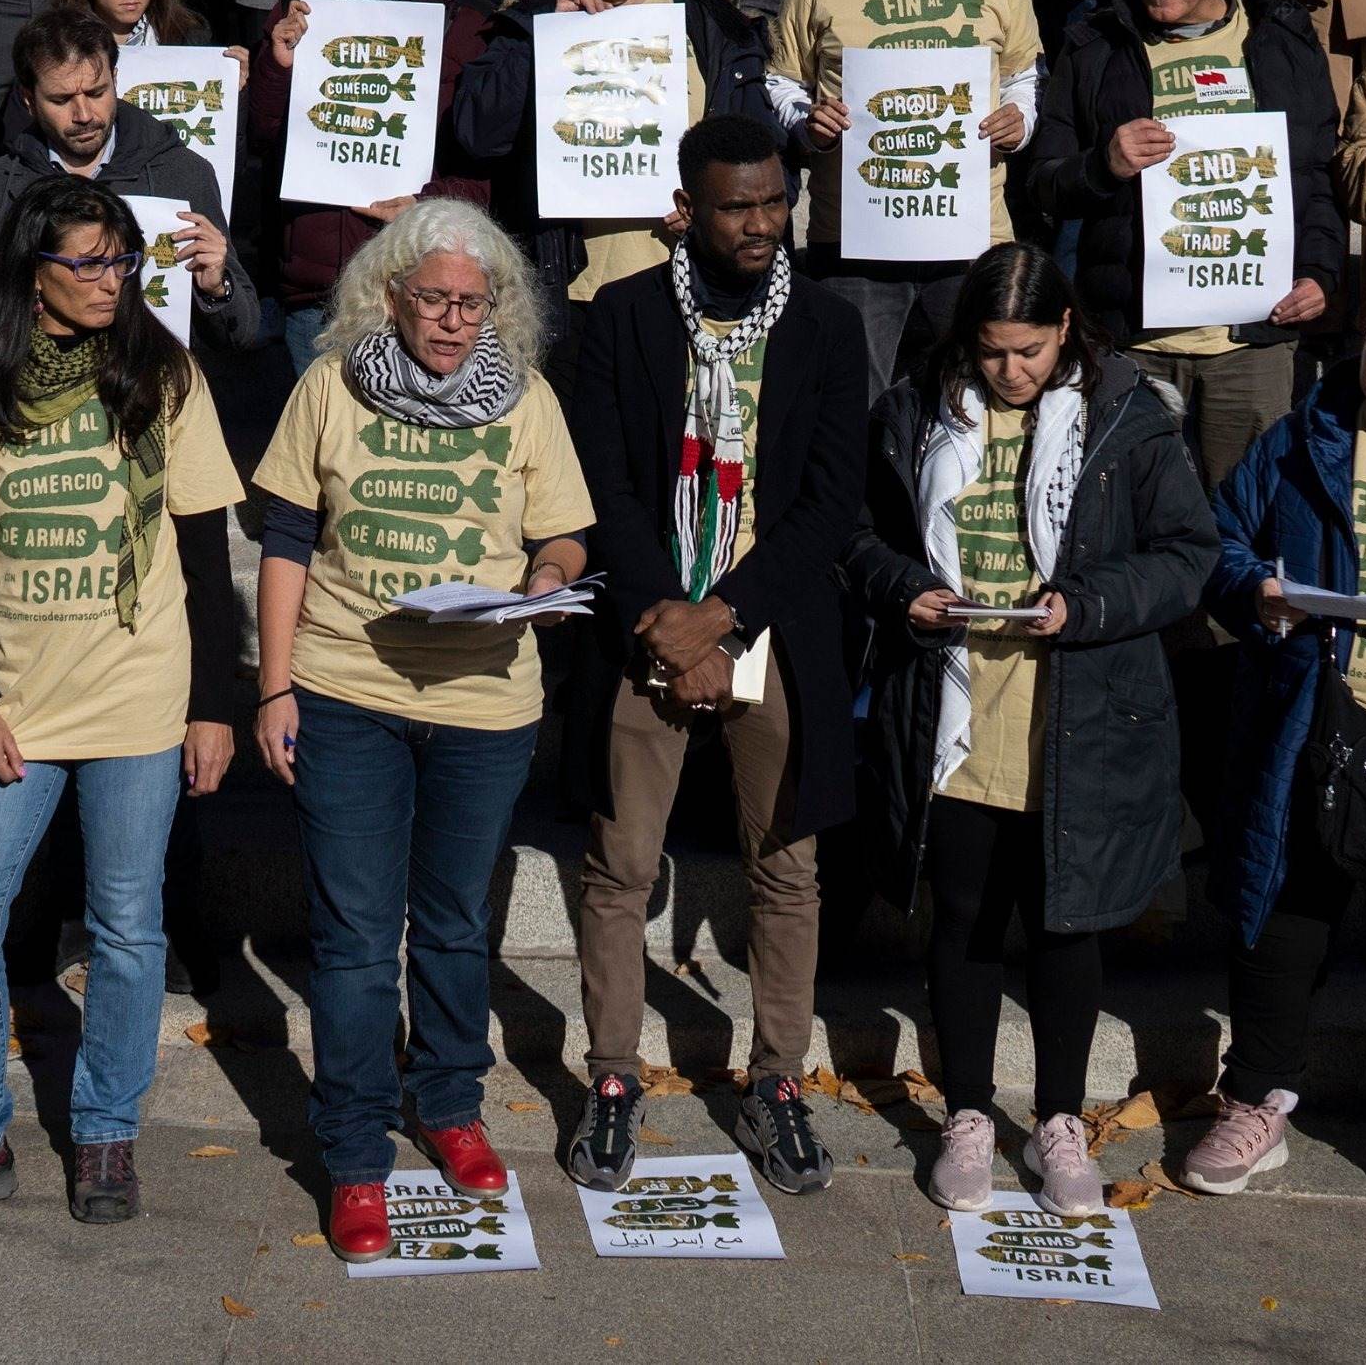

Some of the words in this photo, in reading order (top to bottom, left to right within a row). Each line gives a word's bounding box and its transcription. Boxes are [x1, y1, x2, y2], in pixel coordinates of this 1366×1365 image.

[340, 43, 370, 63] FIN
[1159, 65, 1196, 91] FIN
[327, 83, 387, 96] COMERCIO
[1200, 89, 1247, 97] INTERSINDICAL
[138, 91, 169, 110] FIN
[319, 111, 331, 124] DE
[335, 114, 374, 130] ARMAS
[575, 122, 625, 141] TRADE
[876, 132, 934, 151] COMERÇ
[330, 140, 401, 167] ISRAEL
[582, 153, 659, 178] ISRAEL
[1189, 154, 1236, 182] END
[869, 166, 930, 185] D'ARMES
[884, 195, 958, 219] ISRAEL
[1181, 202, 1196, 212] THE
[1200, 198, 1243, 216] ARMS
[1182, 233, 1231, 250] TRADE
[1188, 263, 1264, 287] ISRAEL
[79, 413, 99, 431] AL
[384, 421, 429, 454] FIN
[440, 433, 457, 449] AL
[8, 473, 102, 500] COMERCIO
[362, 480, 457, 502] COMERCIO
[25, 529, 86, 547] ARMAS
[351, 525, 369, 543] DE
[376, 529, 436, 553] ARMAS
[976, 552, 1025, 571] ARMAS
[1005, 1213, 1062, 1227] END
[400, 1242, 431, 1258] EZ
[1022, 1236, 1076, 1247] ARMS
[1002, 1251, 1064, 1264] TRADE
[1016, 1268, 1115, 1286] ISRAEL
